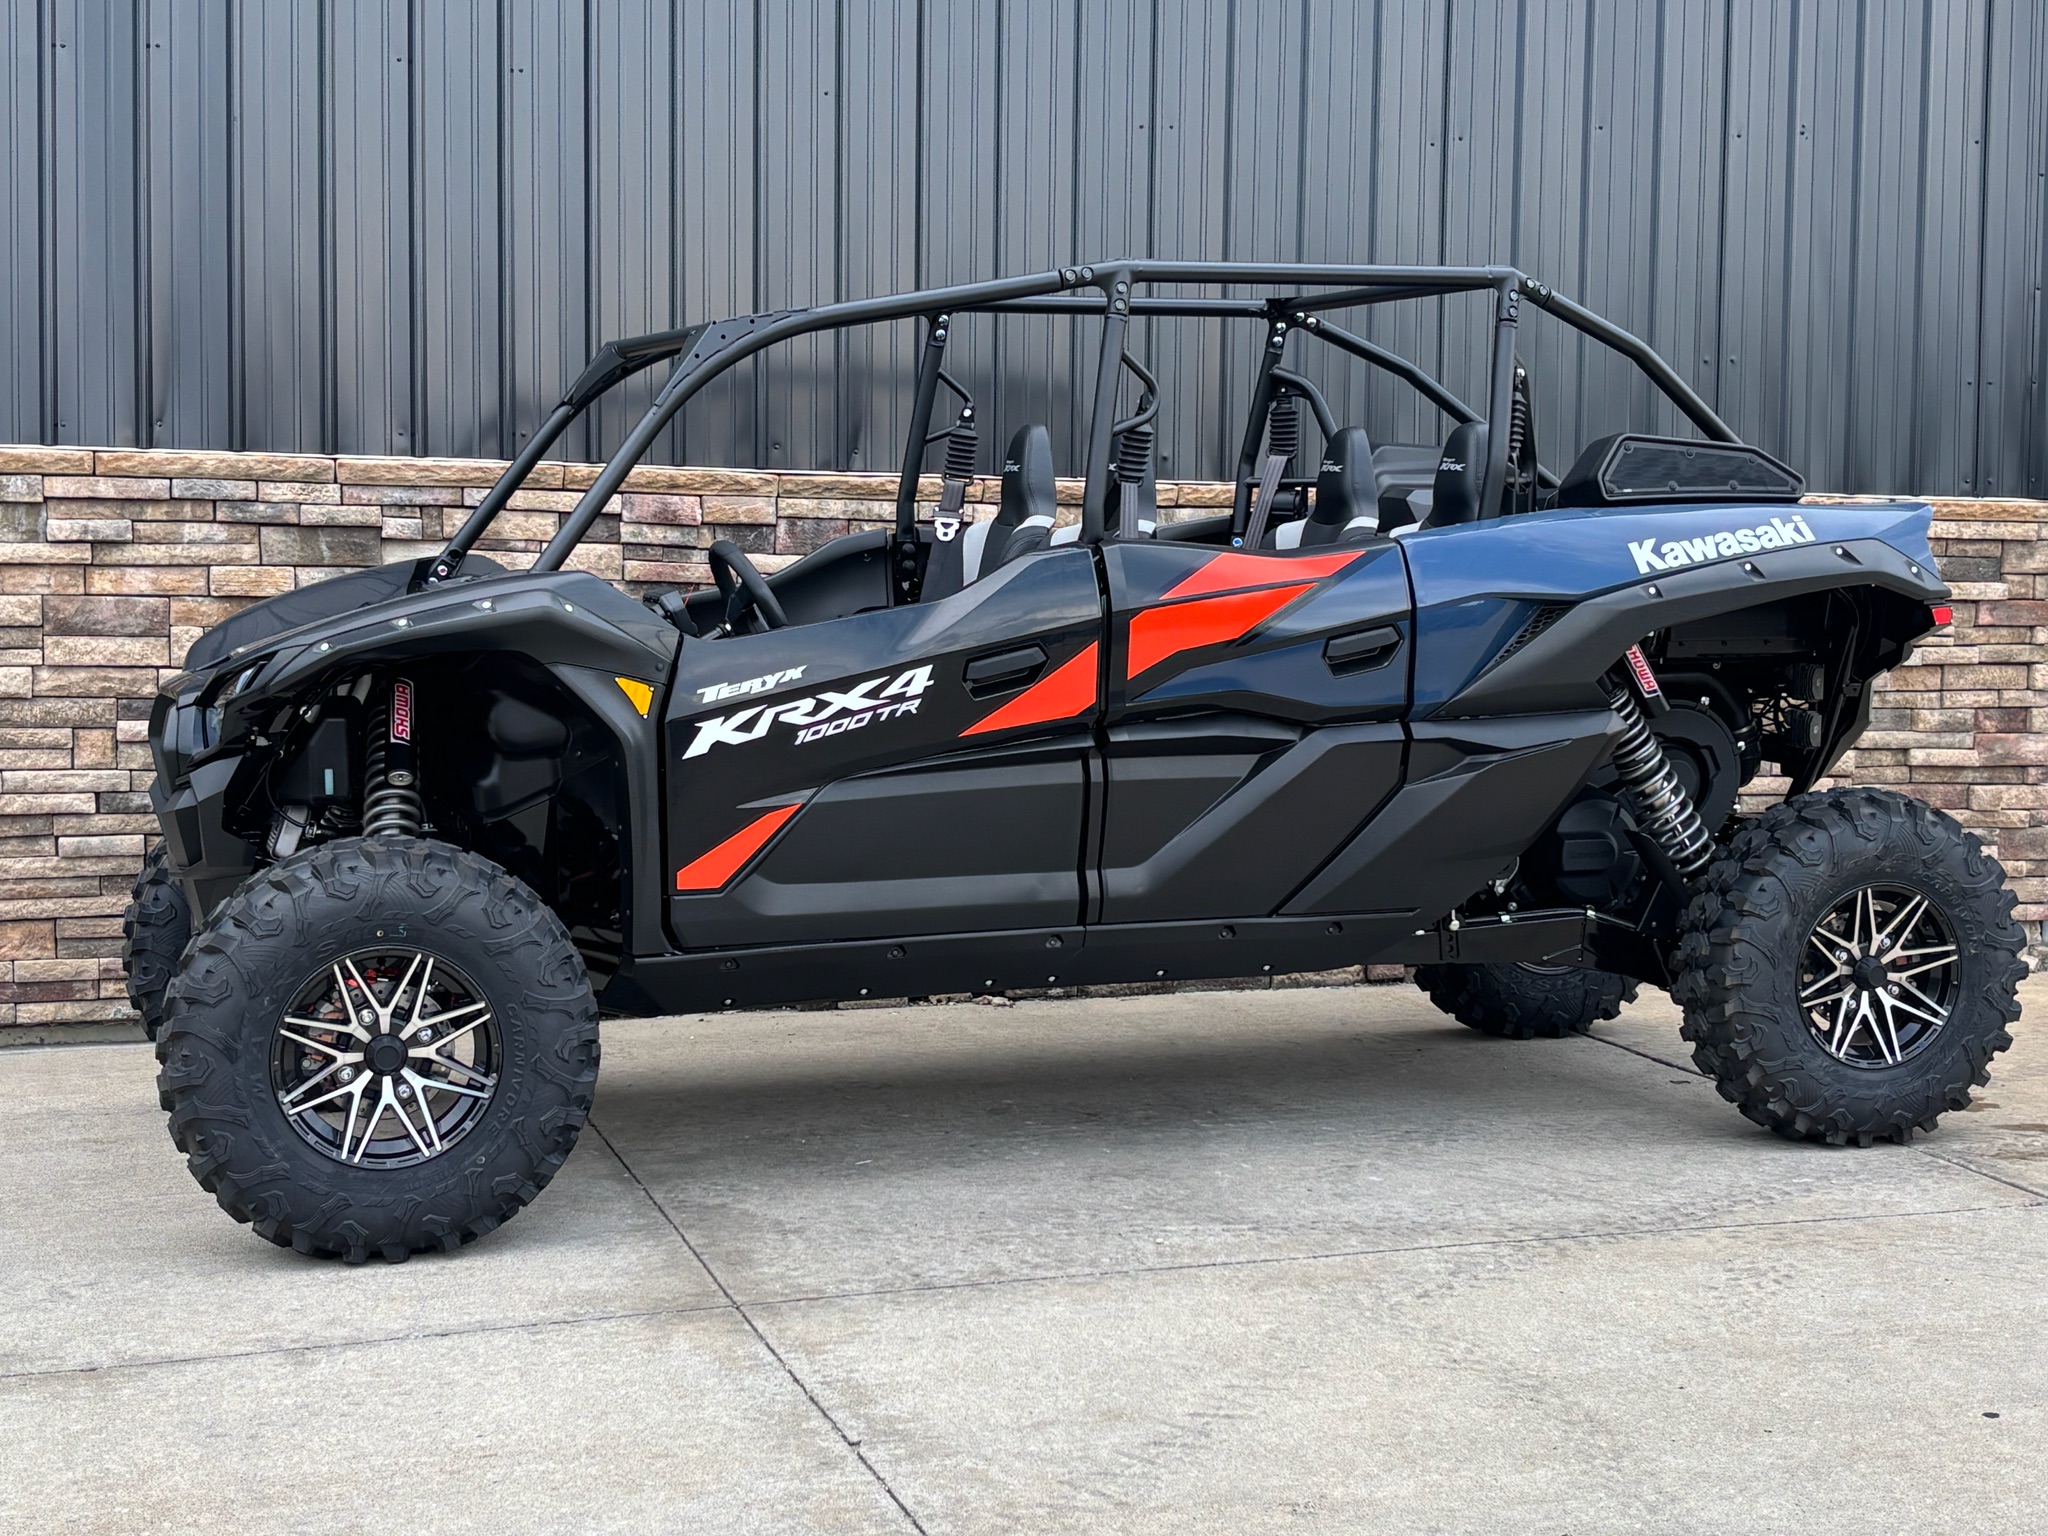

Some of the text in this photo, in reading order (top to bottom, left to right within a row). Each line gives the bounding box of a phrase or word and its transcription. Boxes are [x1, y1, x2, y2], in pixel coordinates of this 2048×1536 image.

[1627, 515, 1816, 575] Kawasaki
[394, 683, 410, 741] SHOWA
[681, 664, 935, 760] KRX4
[488, 1003, 526, 1139] CARNIVORE
